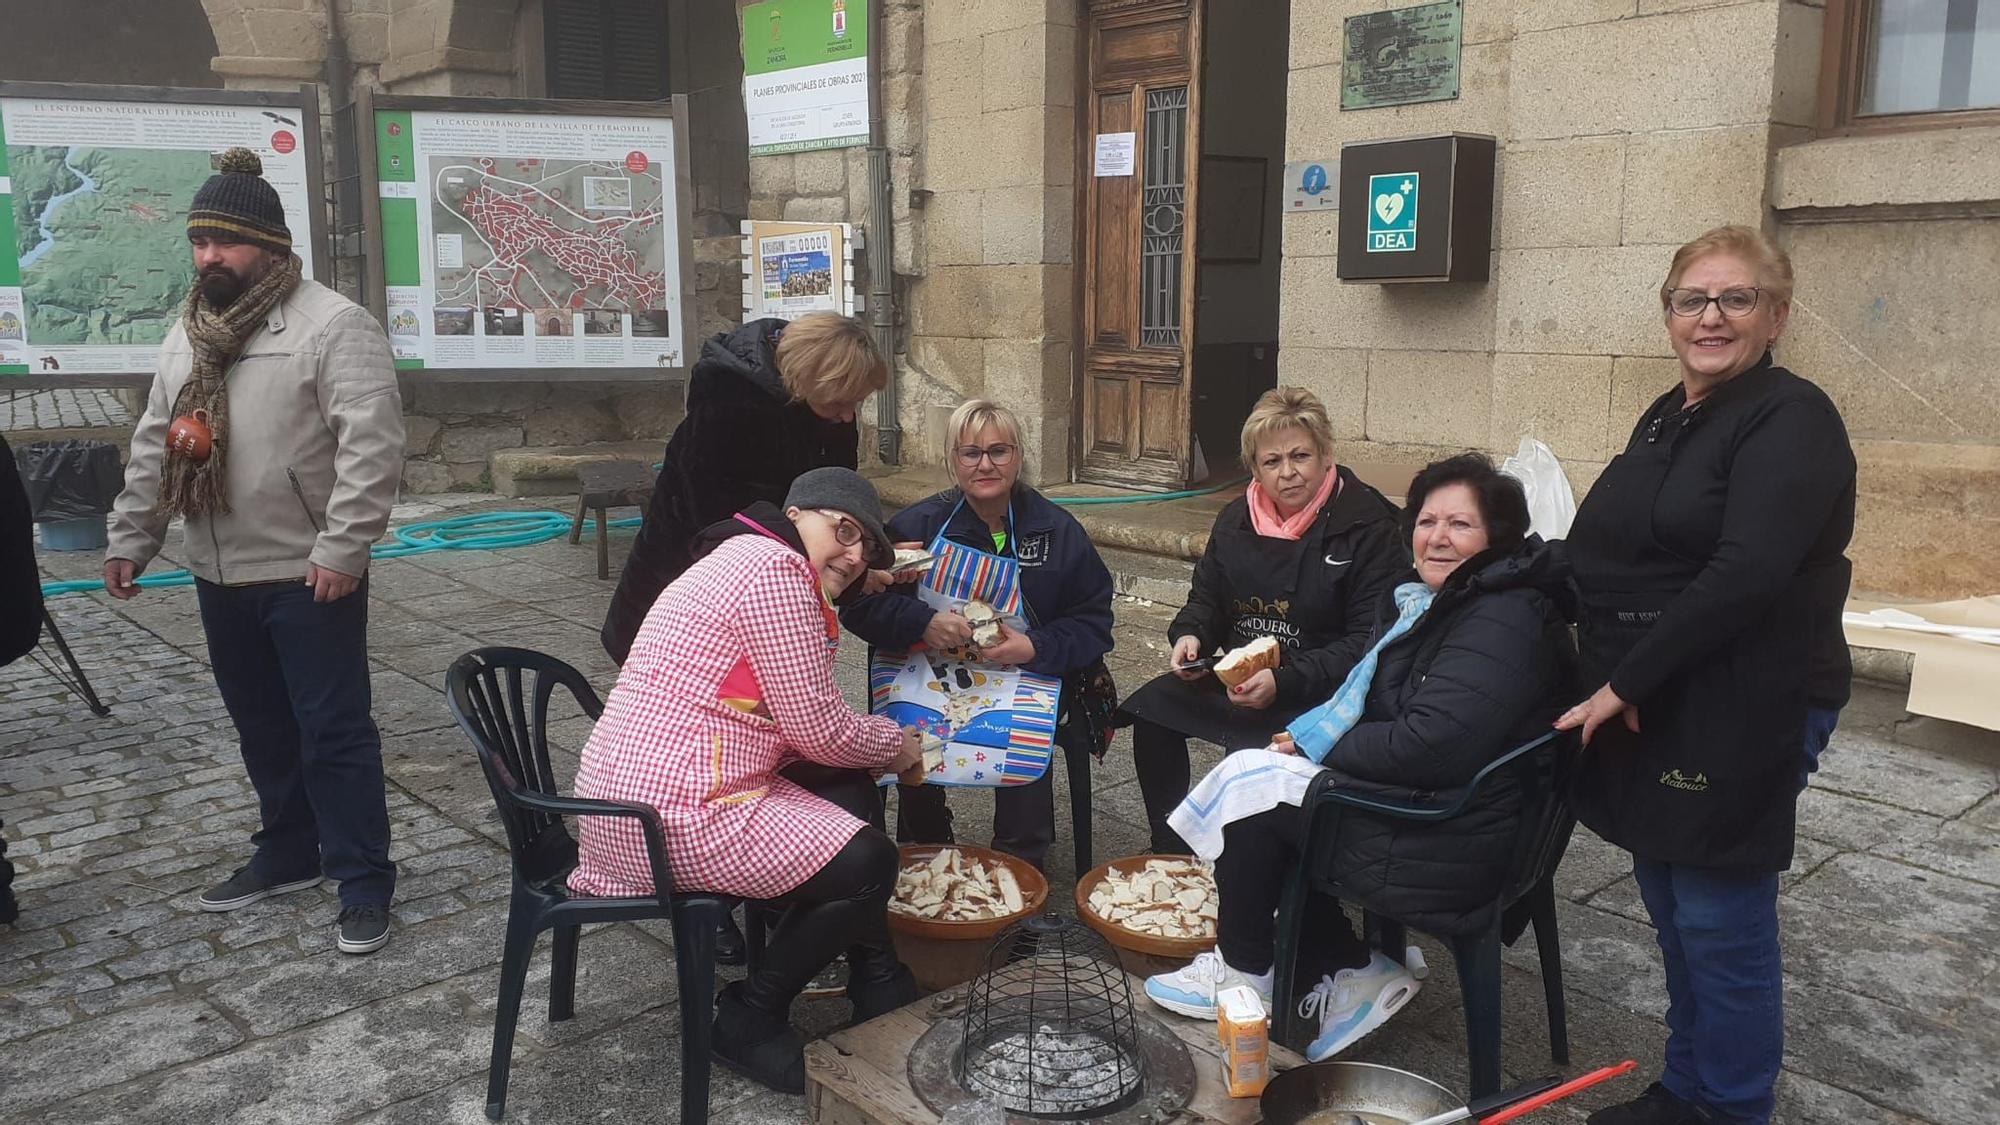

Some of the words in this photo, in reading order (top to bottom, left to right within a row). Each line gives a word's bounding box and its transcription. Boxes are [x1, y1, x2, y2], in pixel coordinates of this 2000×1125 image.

[753, 86, 774, 98] PLANES
[775, 79, 818, 95] PROVINCIALES
[818, 78, 827, 89] DE
[827, 75, 850, 88] OBRAS
[50, 104, 103, 113] ENTORNO
[107, 106, 151, 115] NATURAL
[449, 119, 479, 127] CASCO
[482, 120, 521, 128] URBANO
[553, 122, 578, 130] VILLA
[799, 236, 828, 251] 00000
[1375, 233, 1407, 249] DEA
